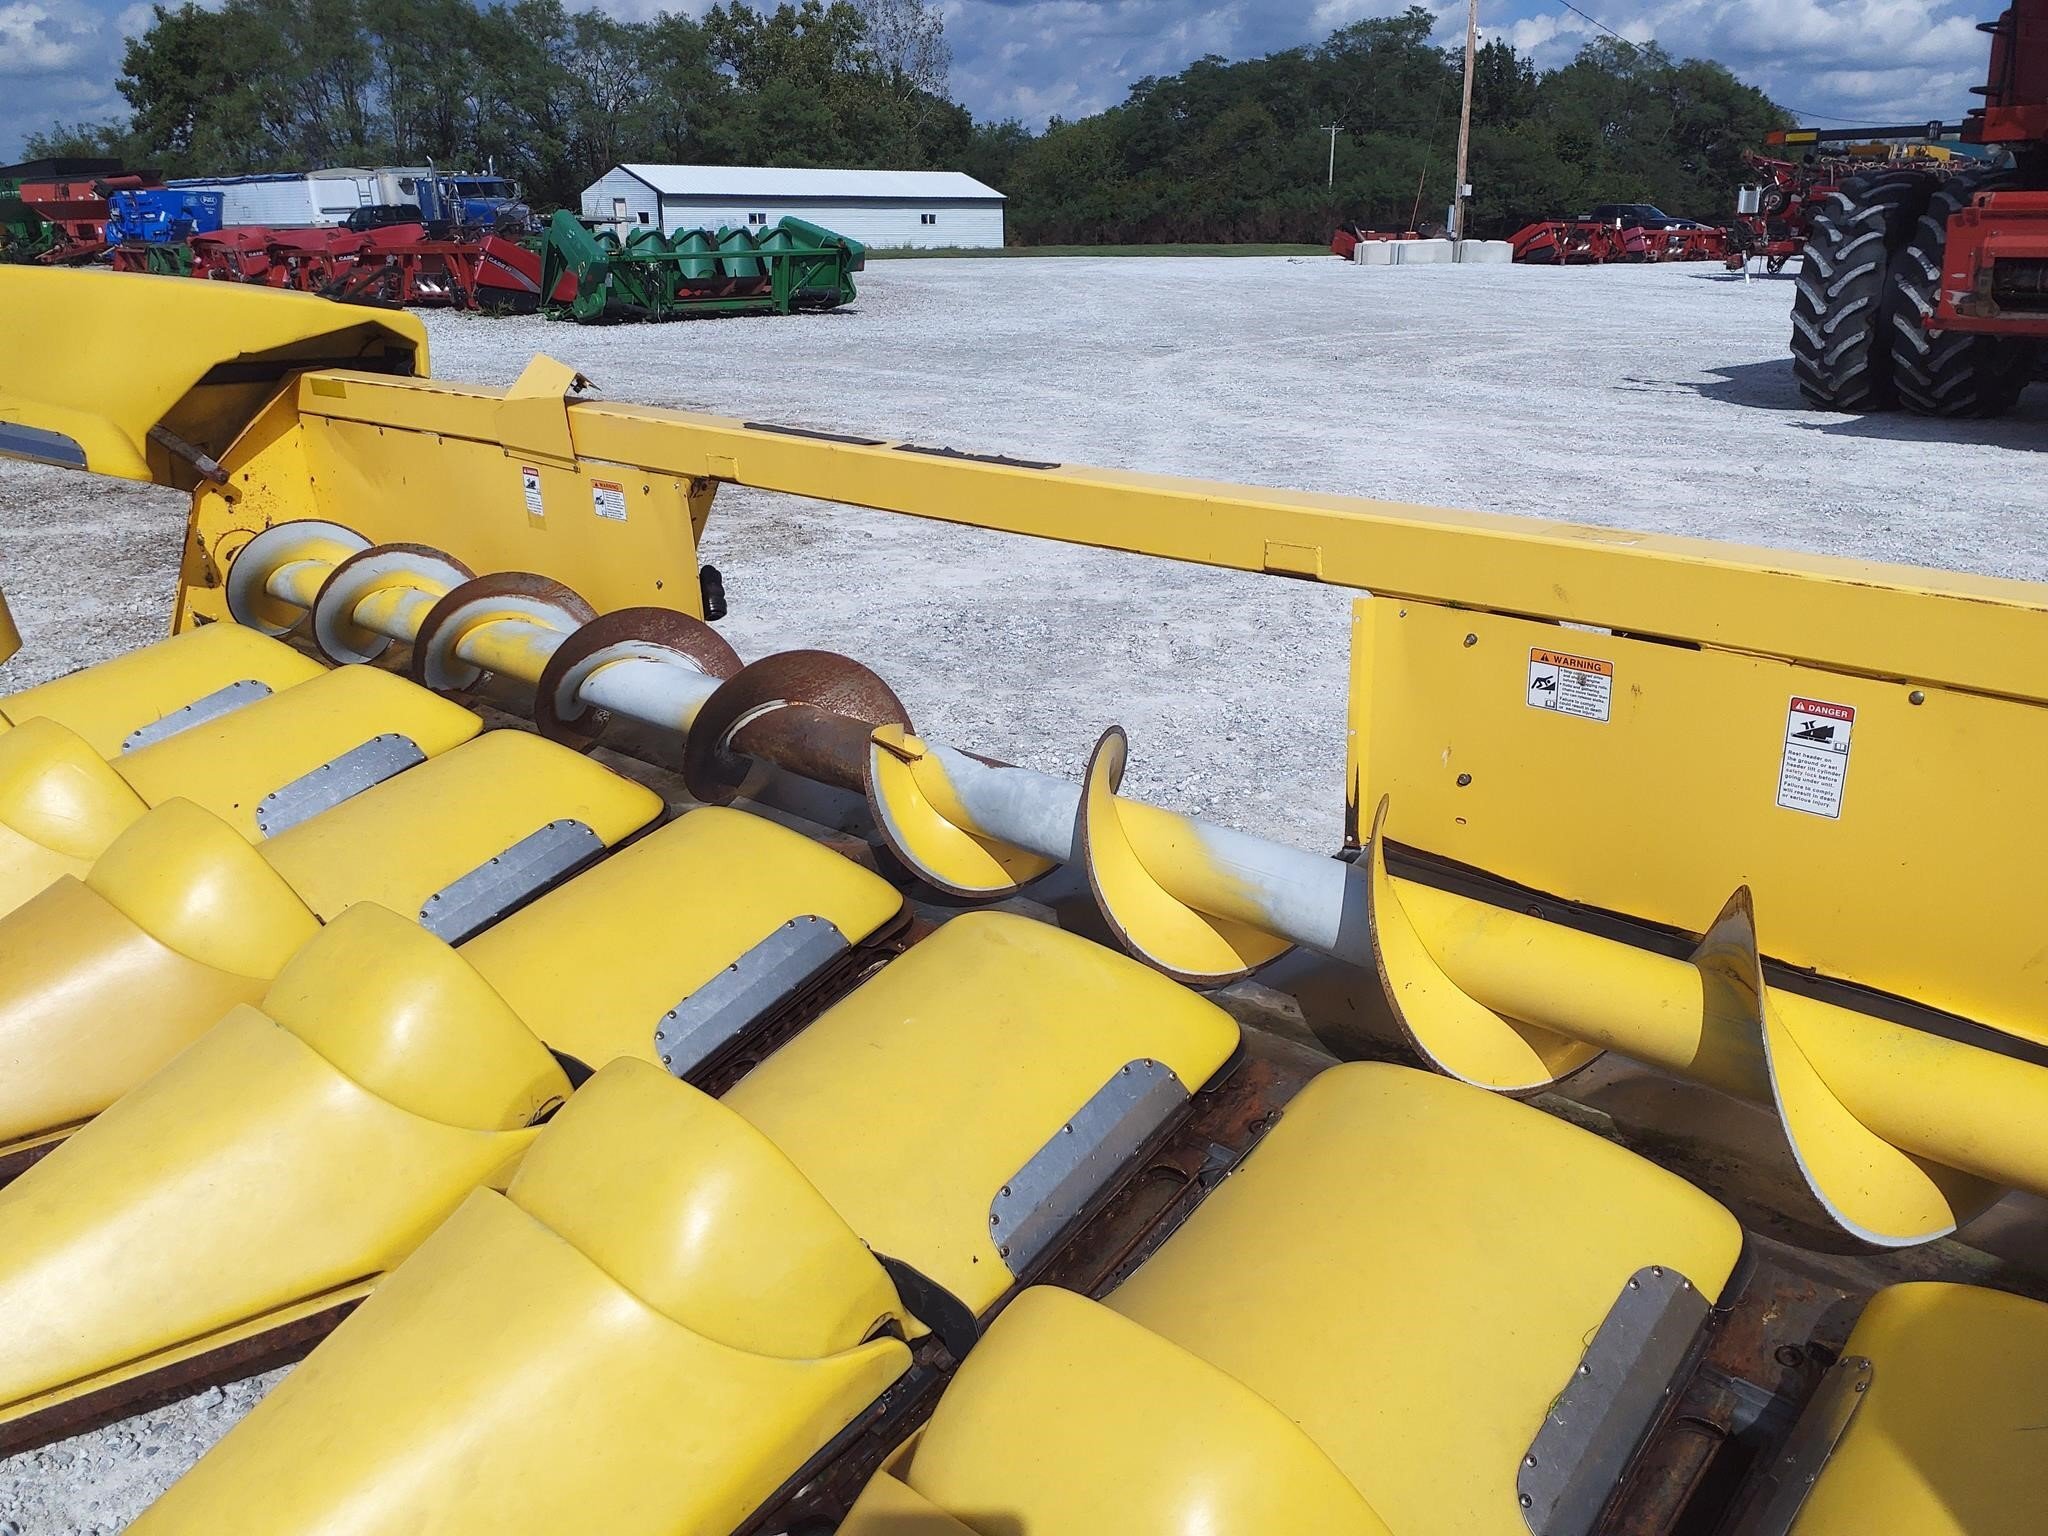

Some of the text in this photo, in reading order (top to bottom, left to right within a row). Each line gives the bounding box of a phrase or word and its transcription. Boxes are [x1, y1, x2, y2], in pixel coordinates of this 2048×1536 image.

[1553, 655, 1602, 671] WARNING
[1808, 704, 1848, 718] DANGER
[1803, 753, 1822, 761] header
[1798, 759, 1819, 767] ground
[1787, 761, 1806, 769] header
[1817, 769, 1841, 777] cylinder
[1819, 774, 1838, 782] before
[1784, 780, 1804, 789] Failure
[1790, 795, 1811, 803] serious
